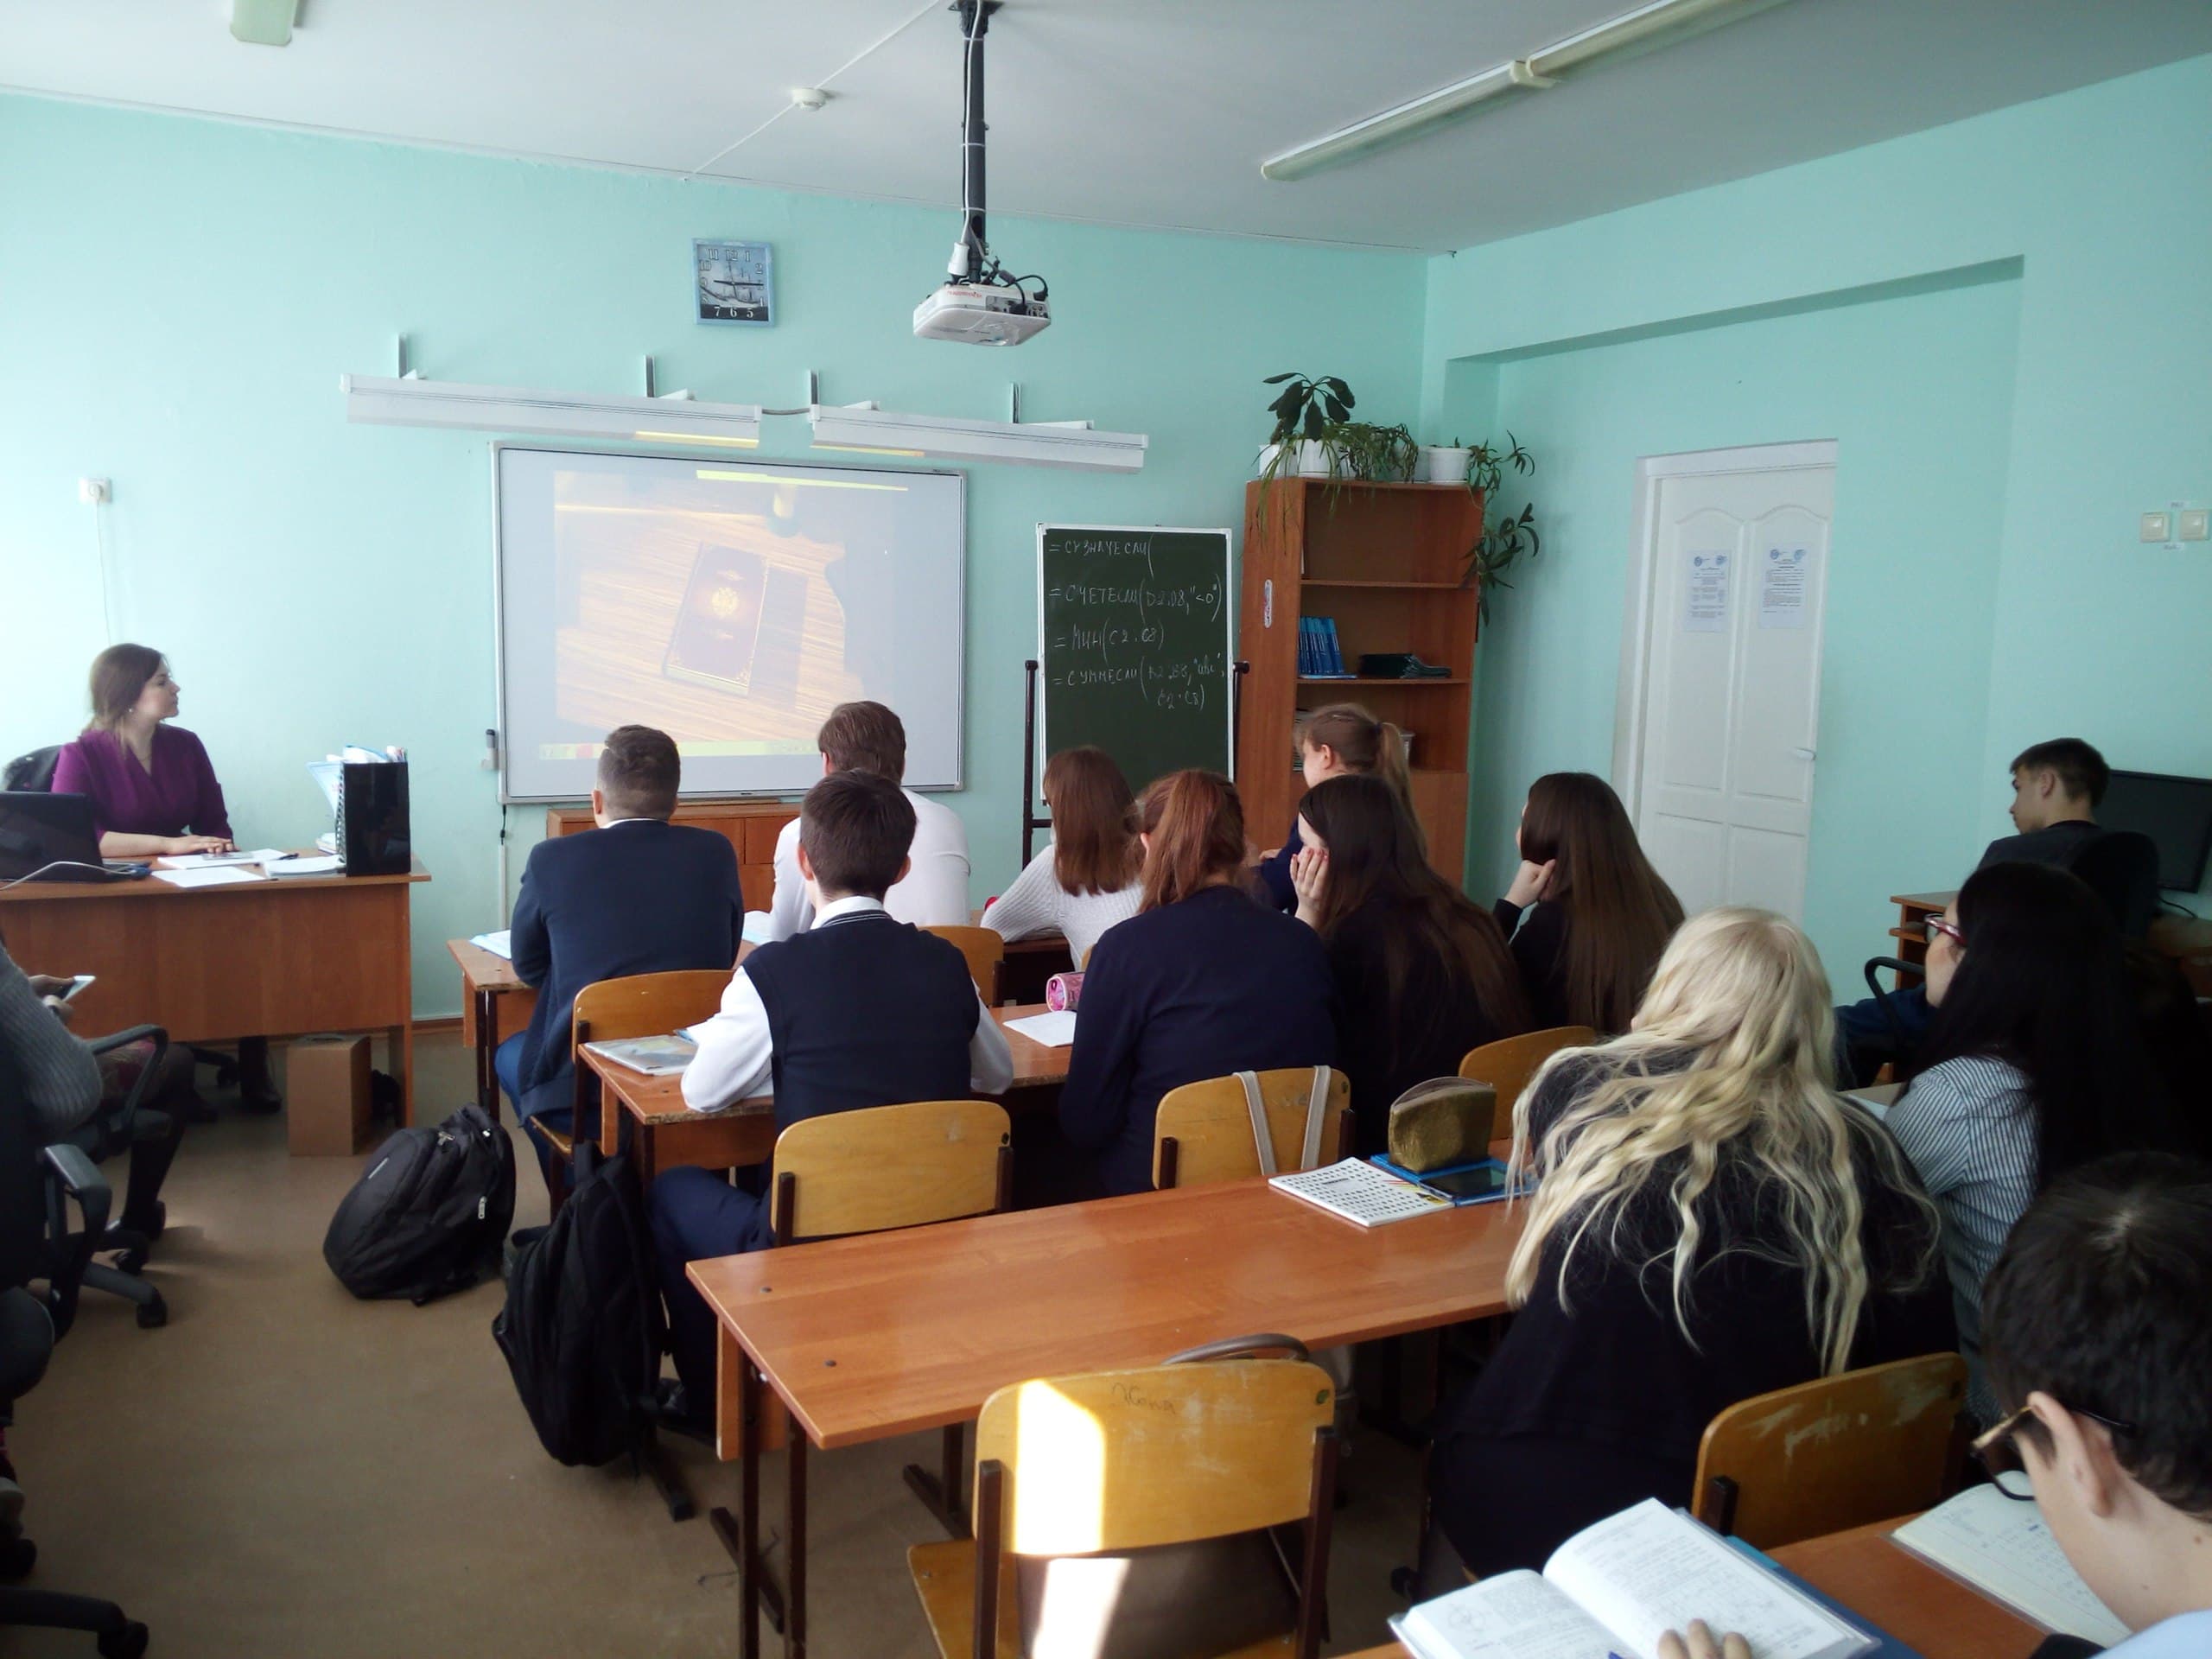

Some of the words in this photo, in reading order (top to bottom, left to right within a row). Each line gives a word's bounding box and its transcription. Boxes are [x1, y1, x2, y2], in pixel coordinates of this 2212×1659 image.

[726, 249, 739, 262] 12
[755, 263, 764, 275] 2
[714, 305, 721, 317] 7
[729, 307, 738, 318] 6
[746, 308, 754, 319] 5
